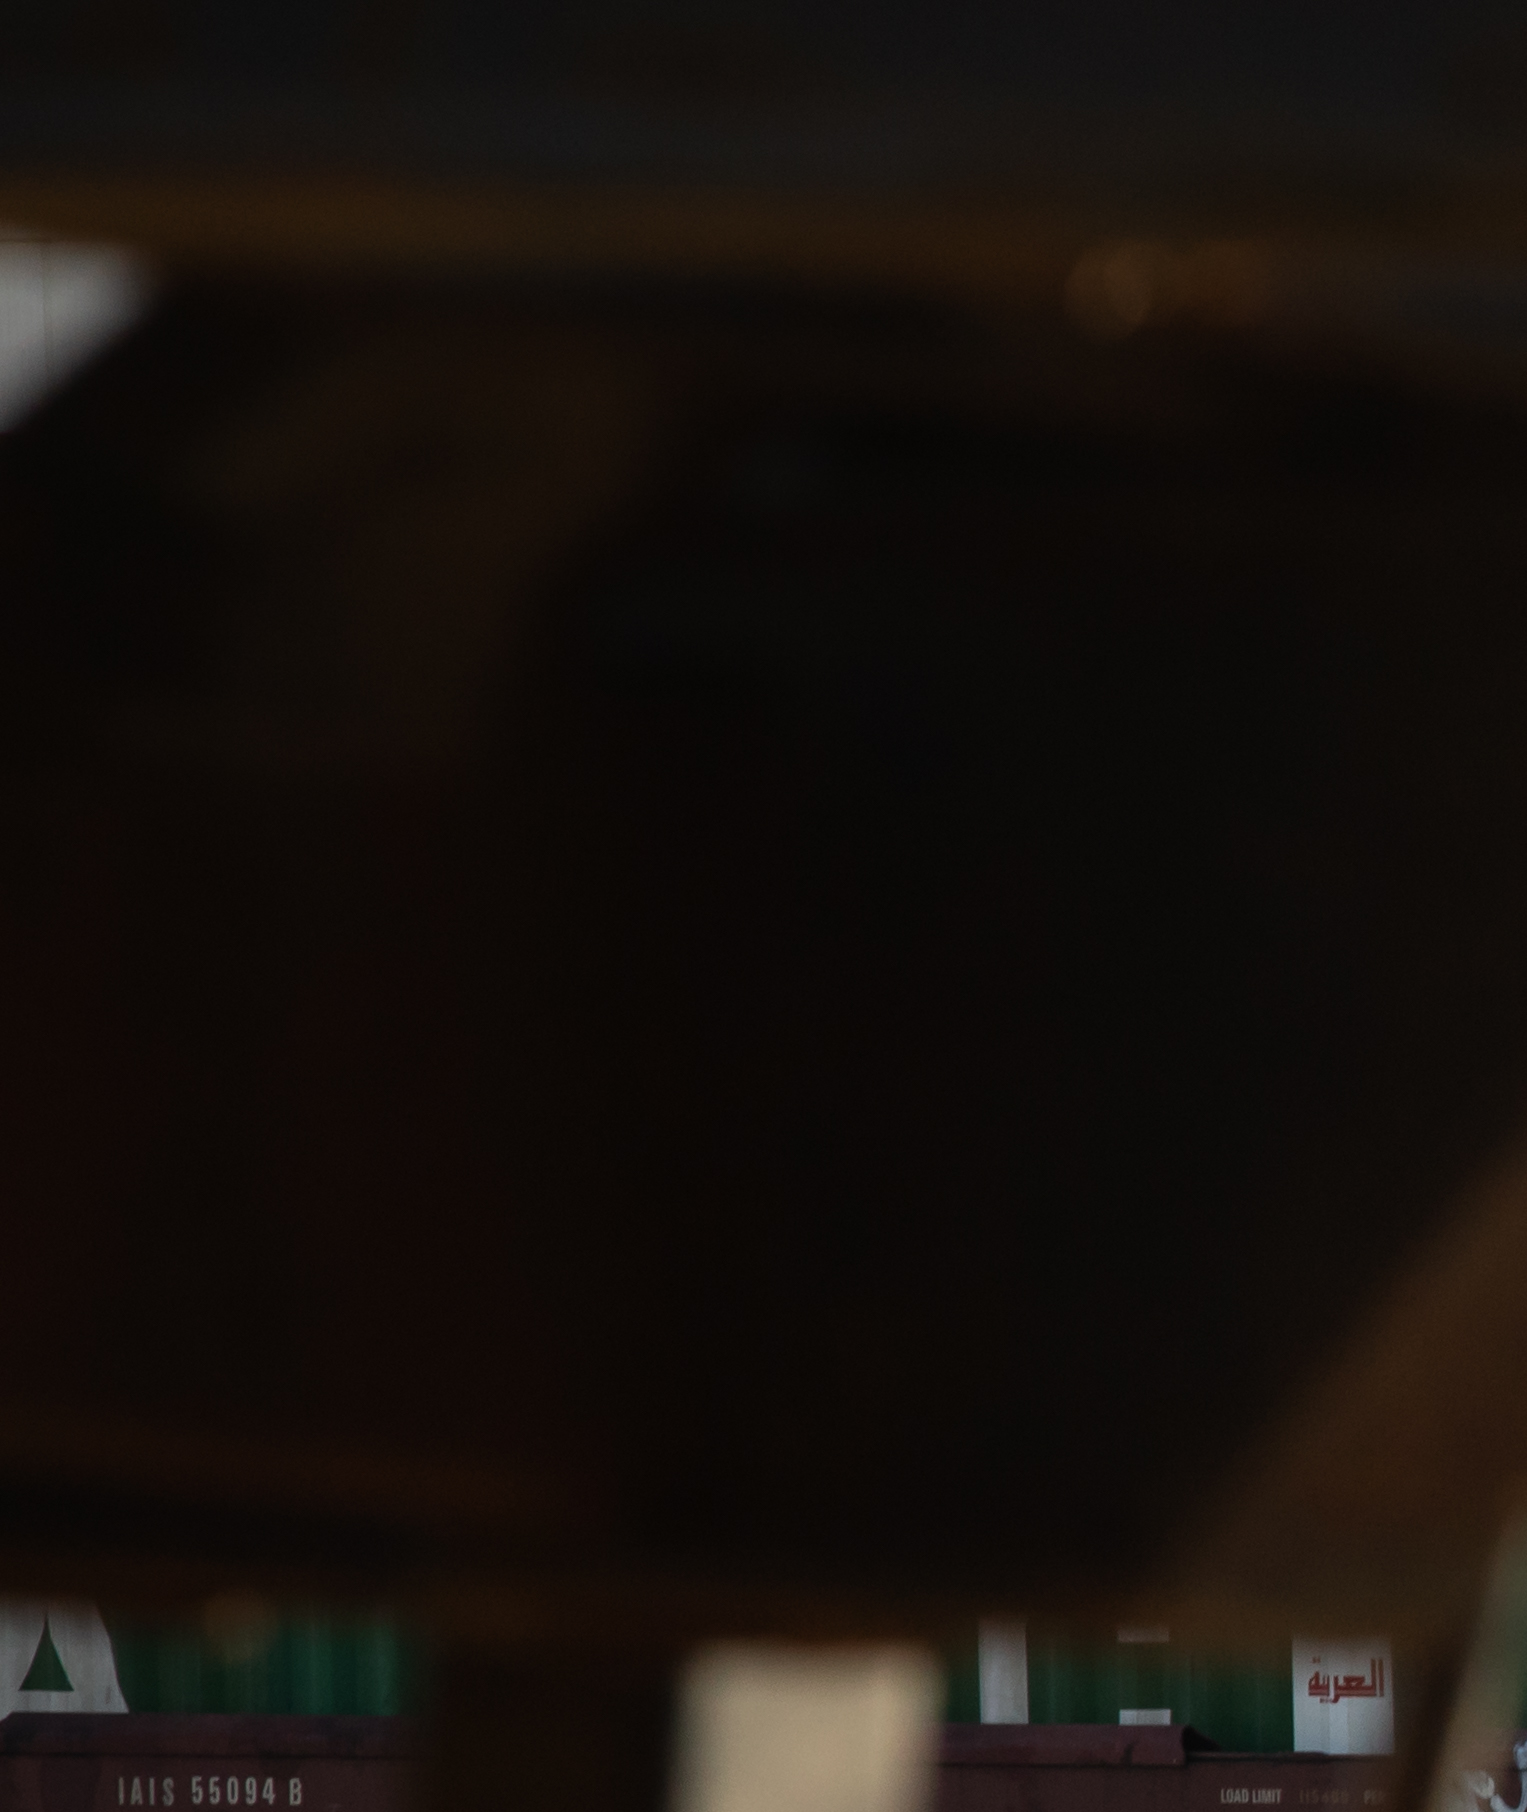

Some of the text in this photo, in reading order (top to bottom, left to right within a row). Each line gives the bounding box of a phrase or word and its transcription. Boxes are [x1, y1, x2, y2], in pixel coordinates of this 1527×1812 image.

[117, 1776, 304, 1806] IAIS 55094 B
[1220, 1788, 1250, 1804] LOAD
[1252, 1788, 1282, 1804] LIMIT
